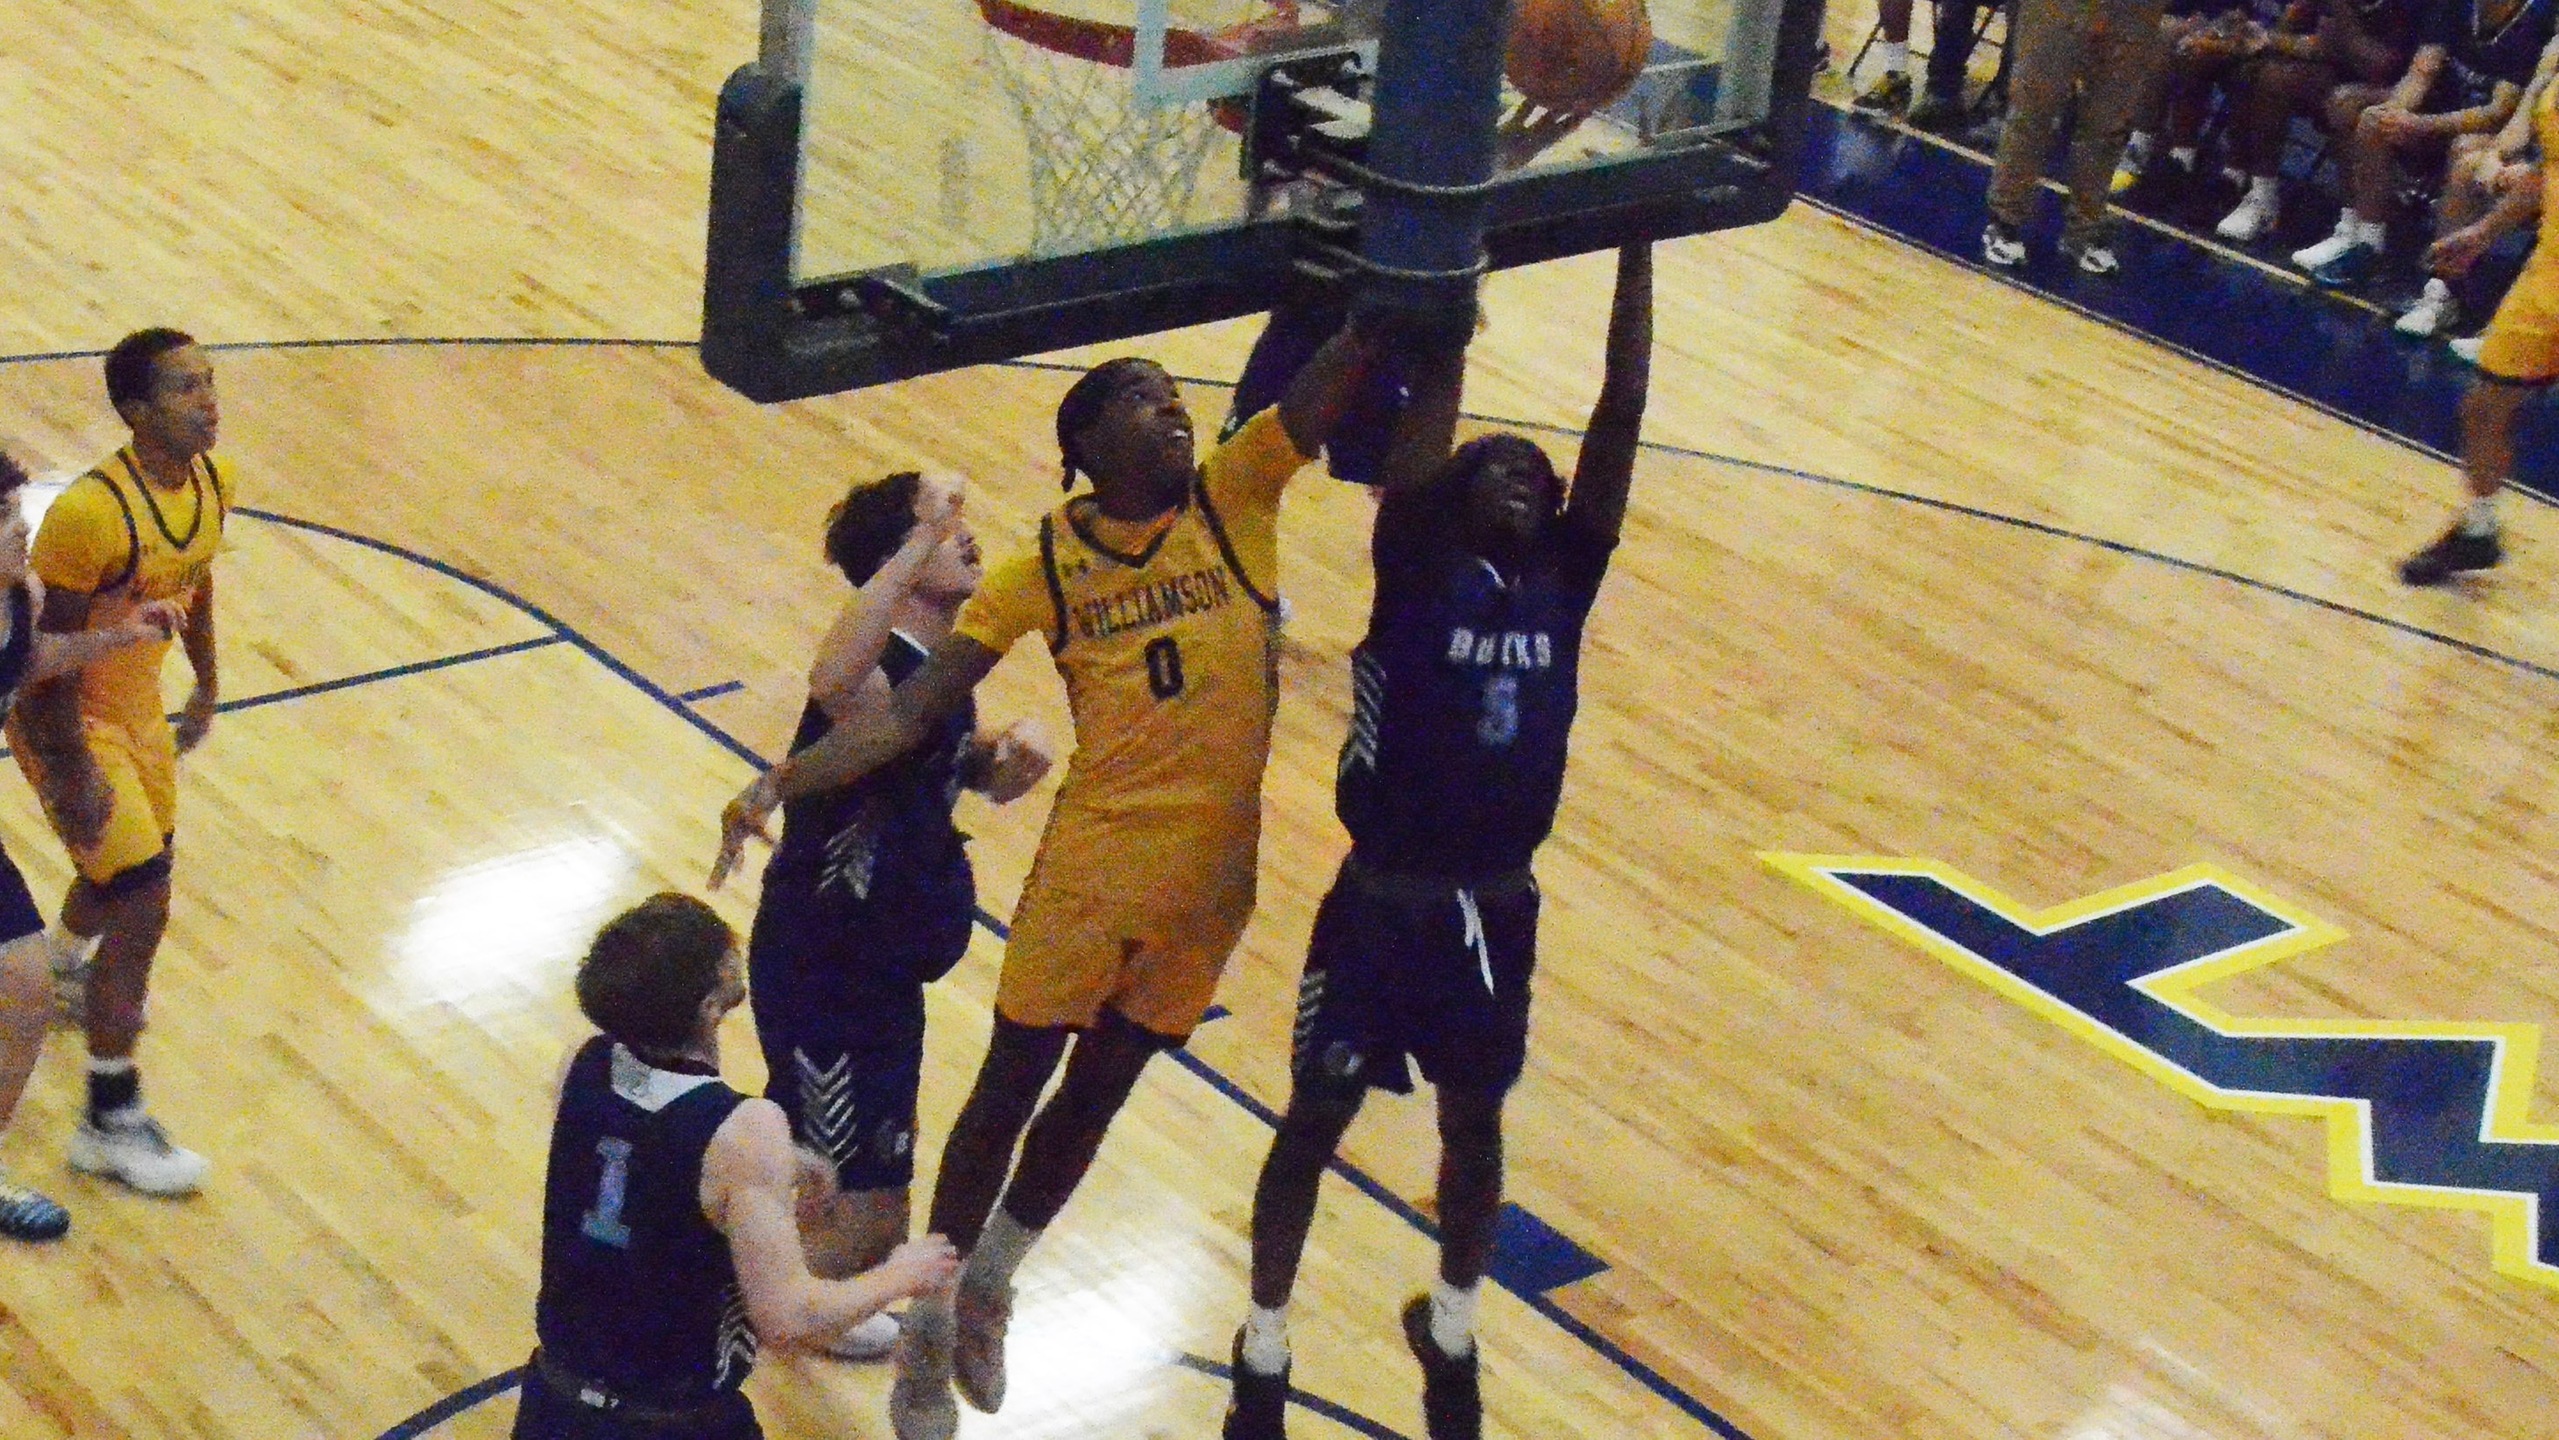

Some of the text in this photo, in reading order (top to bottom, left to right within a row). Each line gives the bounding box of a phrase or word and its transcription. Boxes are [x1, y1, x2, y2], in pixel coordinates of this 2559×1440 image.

[1072, 567, 1230, 637] WILLIAMSON
[1144, 636, 1184, 699] 0
[581, 1137, 632, 1248] 1
